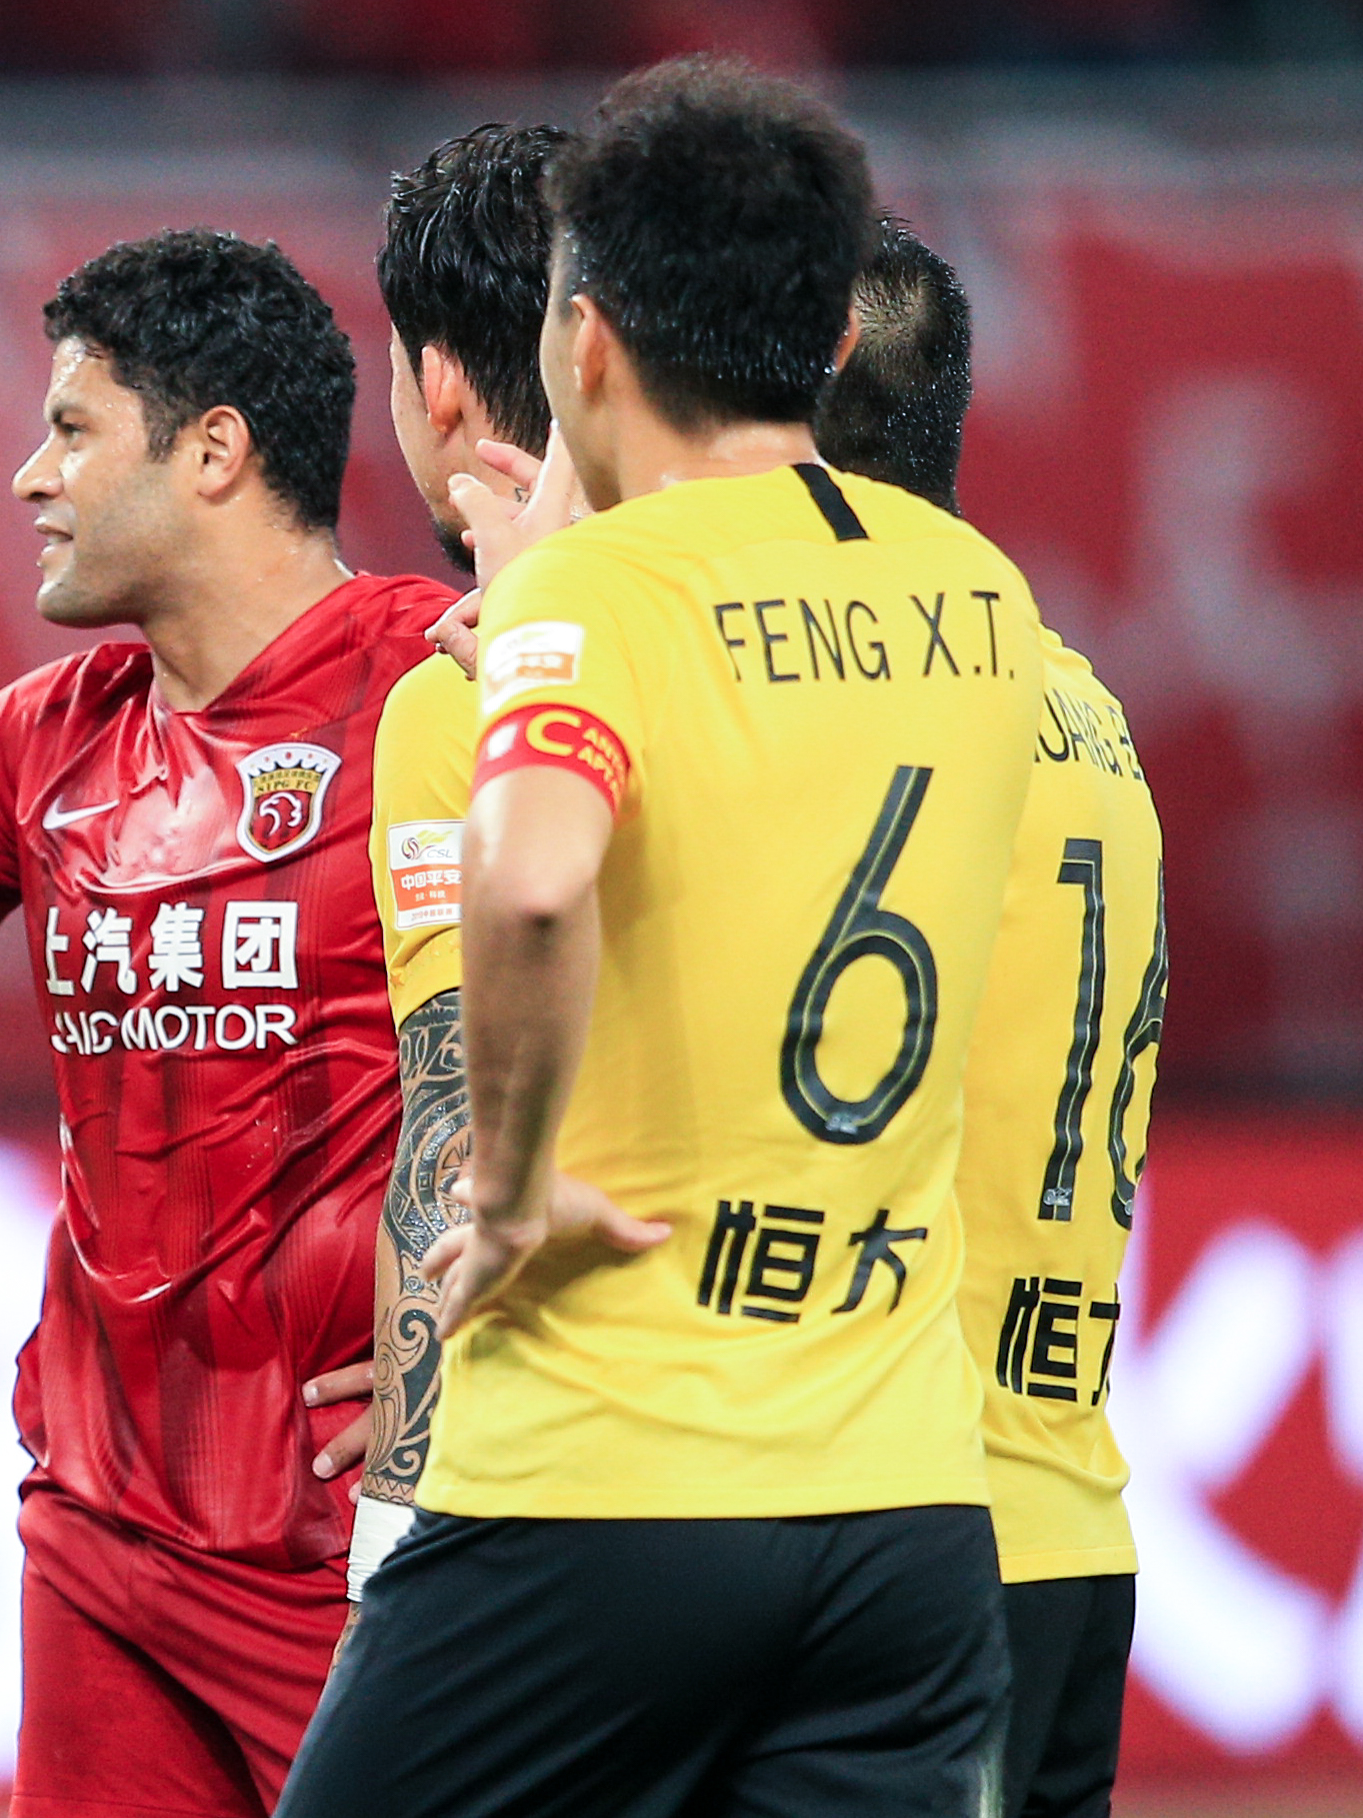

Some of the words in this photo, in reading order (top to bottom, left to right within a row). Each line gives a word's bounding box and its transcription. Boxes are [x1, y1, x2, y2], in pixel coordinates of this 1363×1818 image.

[713, 600, 892, 684] FENG
[909, 590, 1015, 681] X.T.
[1034, 687, 1124, 778] UANG
[426, 848, 453, 859] CSL
[45, 901, 299, 996] 上汽集团
[780, 765, 938, 1145] 6
[120, 1004, 299, 1051] MOTOR
[696, 1200, 928, 1324] 恒大
